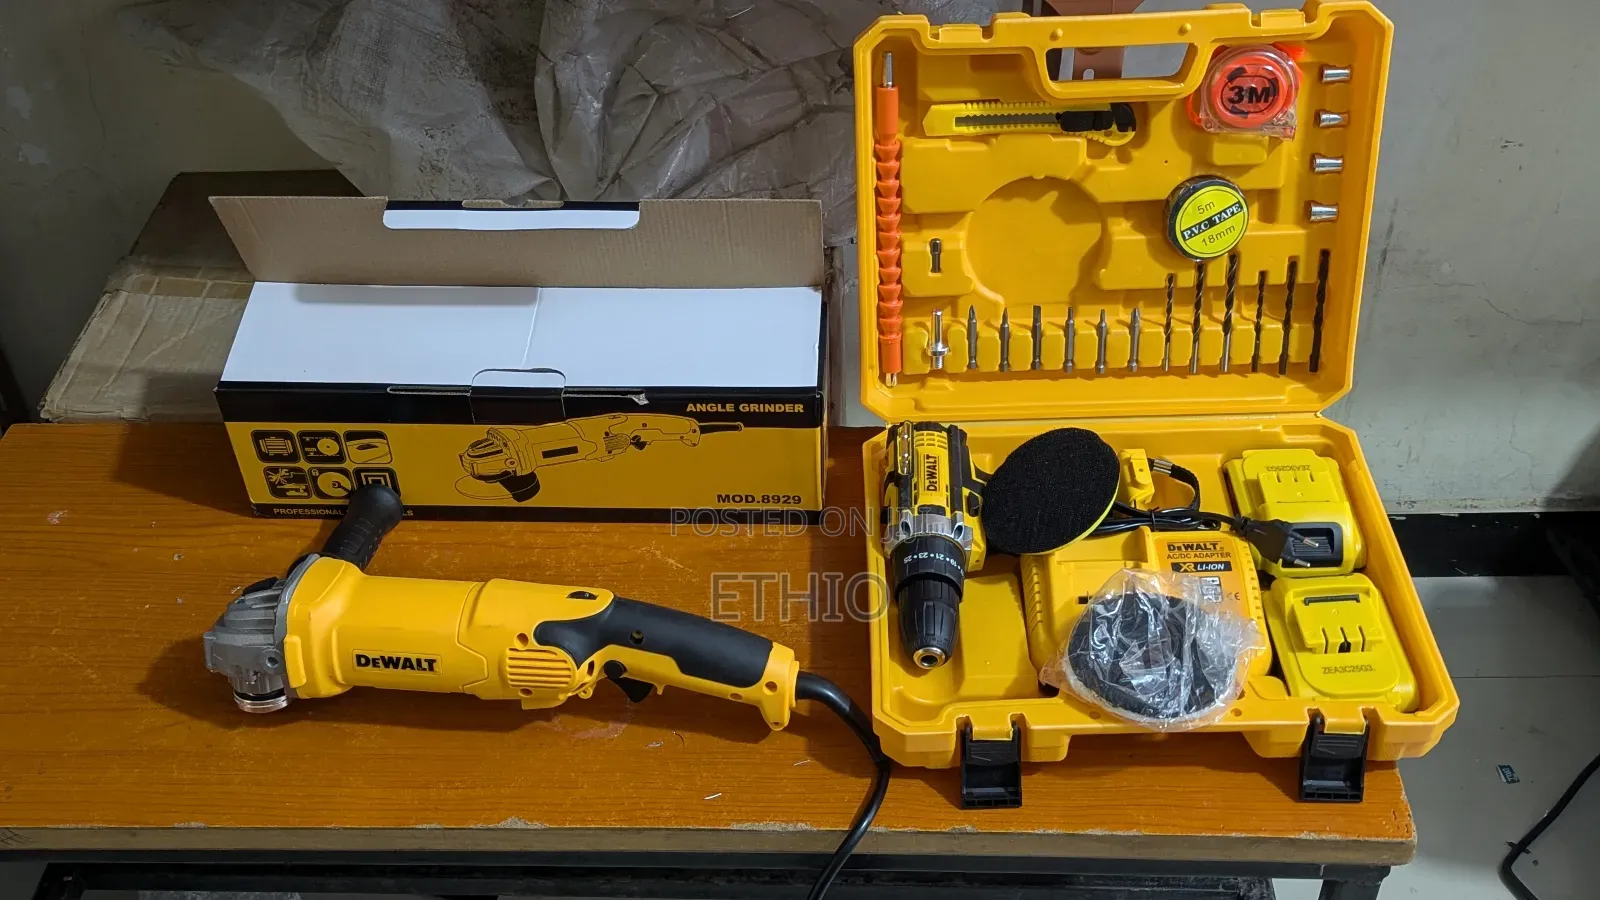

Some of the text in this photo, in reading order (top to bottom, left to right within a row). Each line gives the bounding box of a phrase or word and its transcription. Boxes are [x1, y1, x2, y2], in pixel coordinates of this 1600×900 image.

[1227, 86, 1271, 104] 3M
[1197, 201, 1215, 215] 5m
[1183, 204, 1241, 240] P.V.C TAPE
[1201, 225, 1236, 247] 18mm
[686, 403, 804, 413] ANGLE GRINDER
[716, 494, 802, 504] MOD.8929
[273, 508, 344, 516] PROFESSIONAL
[1197, 563, 1225, 571] LI-ION
